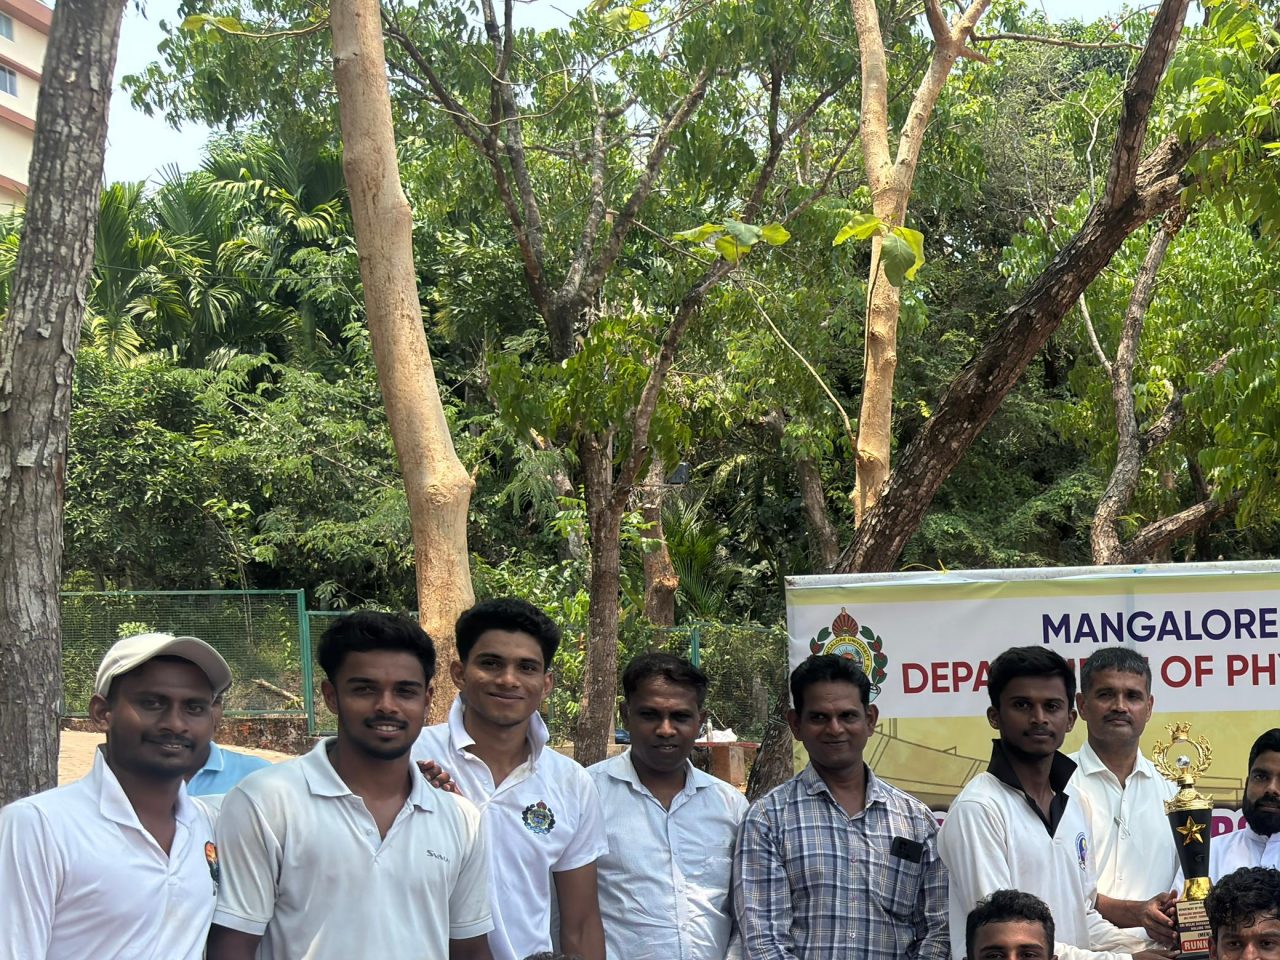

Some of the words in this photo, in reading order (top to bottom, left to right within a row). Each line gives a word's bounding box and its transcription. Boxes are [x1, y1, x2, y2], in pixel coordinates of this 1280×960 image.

[1042, 609, 1279, 644] MANGALORE
[1160, 655, 1213, 688] OF
[1184, 940, 1208, 950] RUNN
